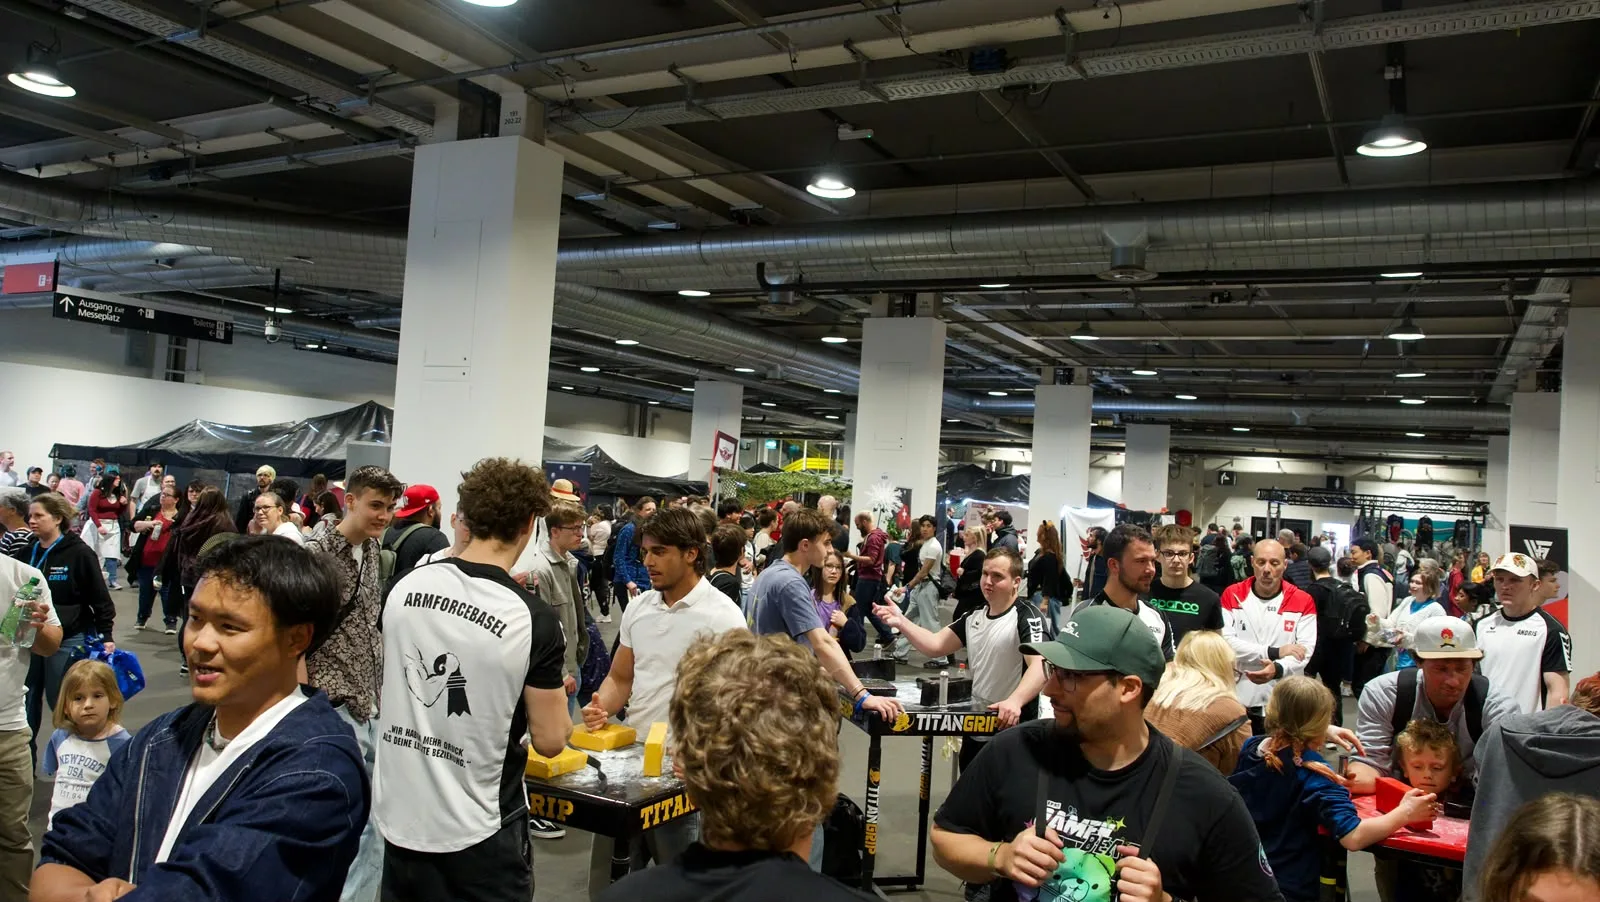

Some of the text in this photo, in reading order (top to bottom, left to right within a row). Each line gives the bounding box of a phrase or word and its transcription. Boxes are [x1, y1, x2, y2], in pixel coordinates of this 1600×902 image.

[79, 299, 125, 314] Ausgang Exit
[78, 308, 121, 323] Messeplatz
[193, 318, 215, 328] Toilette
[403, 592, 508, 639] ARMFORCEBASEL
[1517, 629, 1538, 637] ANDRIS
[383, 732, 392, 743] ALS
[393, 736, 412, 748] DEINE
[423, 735, 442, 748] MEHR
[443, 741, 464, 757] DRUCK
[59, 754, 106, 773] NEWPORT
[67, 765, 84, 779] USA
[865, 785, 880, 855] TITANGRIP
